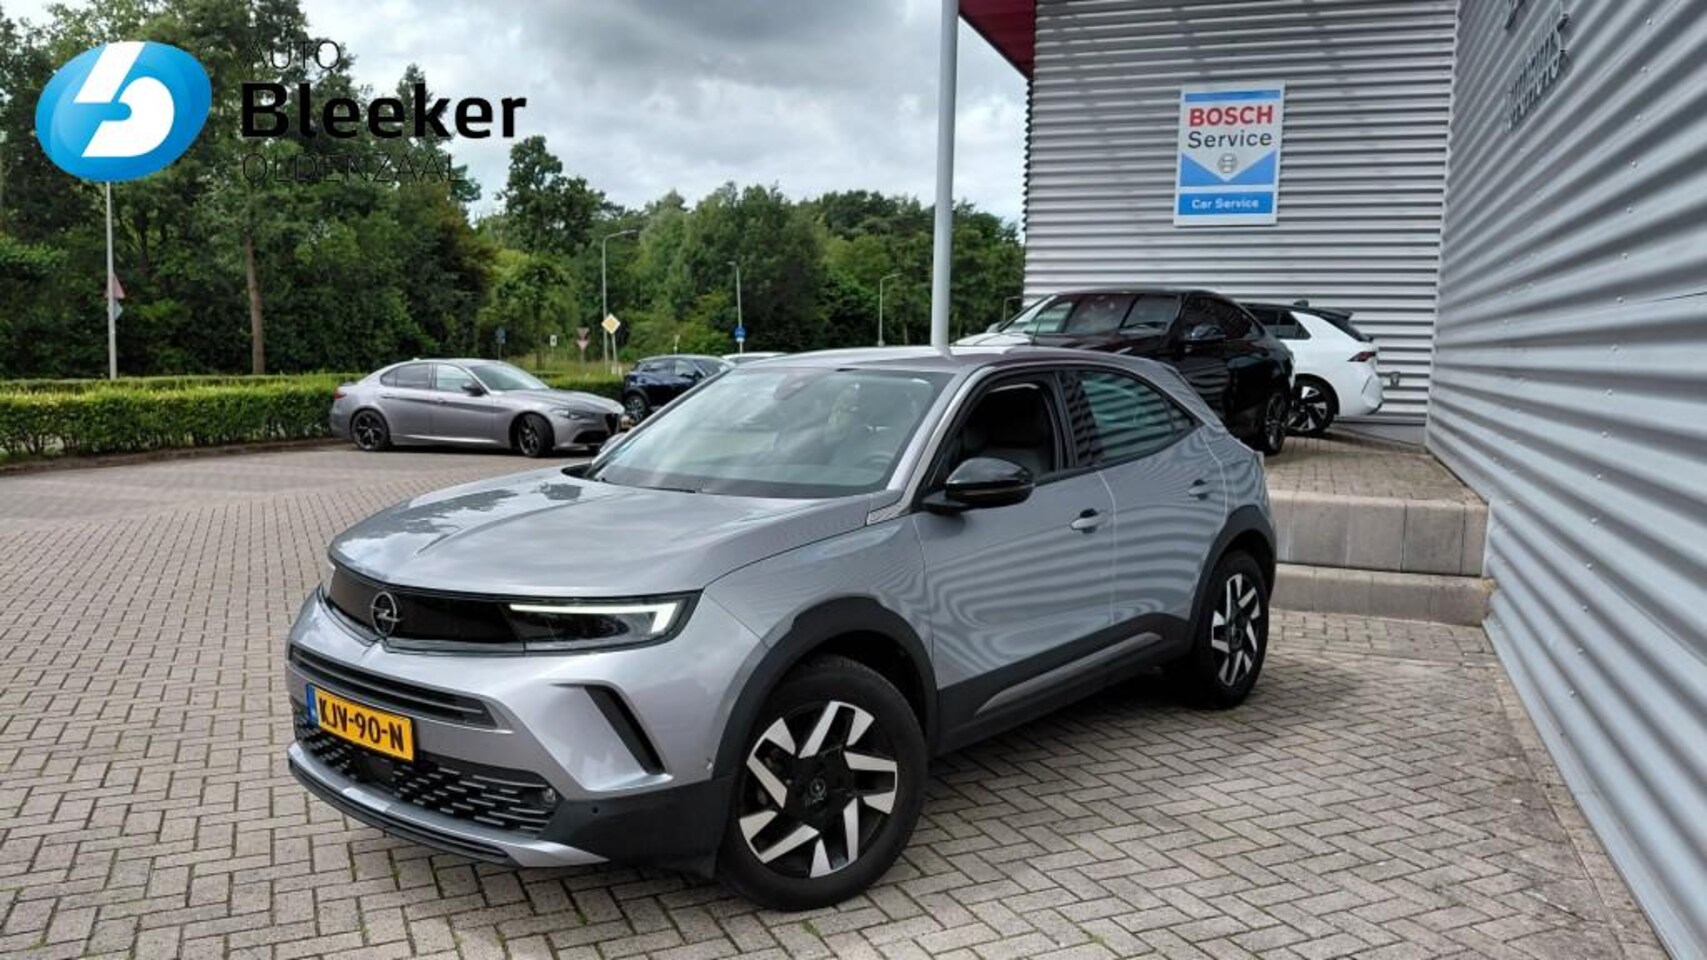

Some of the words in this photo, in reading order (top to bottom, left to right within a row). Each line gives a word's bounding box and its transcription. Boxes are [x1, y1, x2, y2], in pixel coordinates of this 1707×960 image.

[1189, 105, 1273, 127] BOSCH
[1188, 129, 1273, 149] Service
[1191, 199, 1212, 209] Car
[1215, 198, 1259, 209] Service
